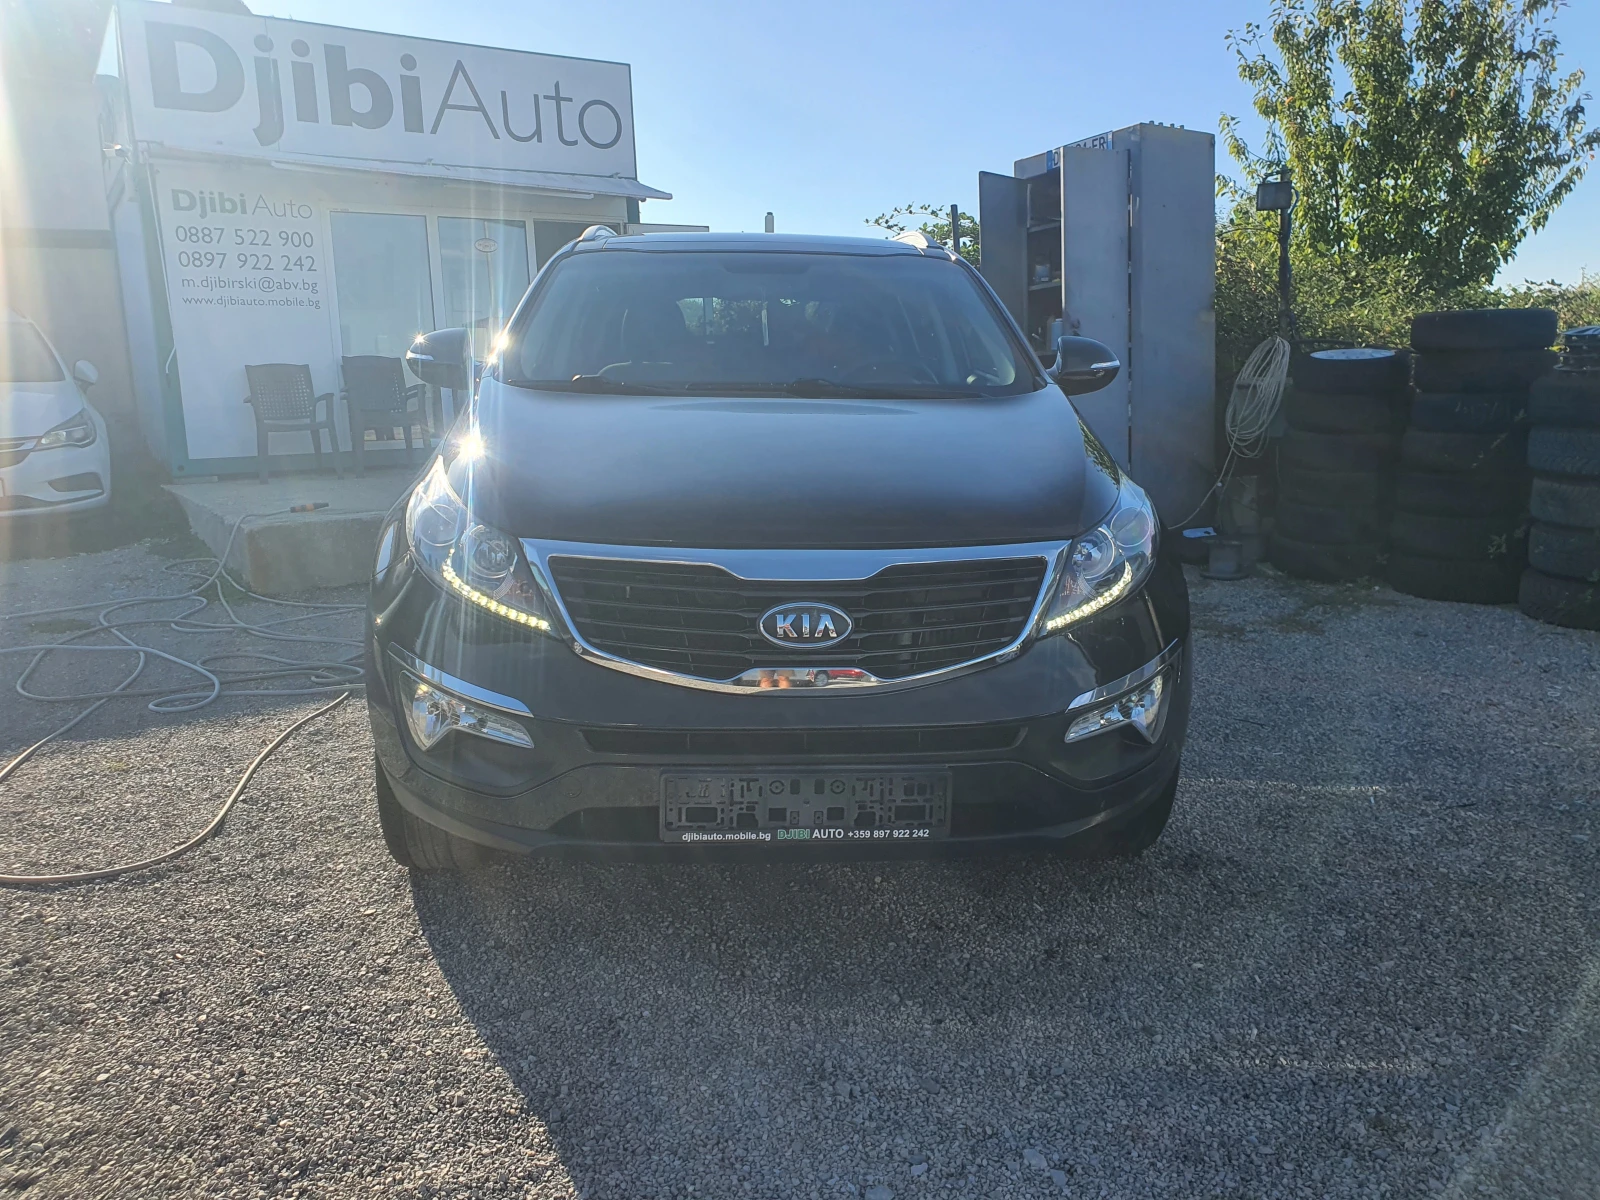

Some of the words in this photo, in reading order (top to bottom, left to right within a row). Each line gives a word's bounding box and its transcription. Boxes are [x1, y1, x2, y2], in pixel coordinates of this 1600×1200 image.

[175, 225, 225, 244] 0887
[234, 228, 272, 246] 522
[278, 230, 314, 248] 900
[178, 251, 227, 269] 0897
[237, 252, 274, 271] 922
[280, 254, 317, 272] 242
[181, 276, 319, 294] m.djibirski@abv.bg
[182, 296, 321, 309] www.djibiauto.mobile.bg
[775, 613, 838, 638] KIA
[682, 832, 771, 842] djibiauto.mobile.bg
[777, 829, 811, 840] DJIBI
[812, 828, 844, 839] AUTO
[847, 830, 871, 839] +359
[873, 829, 890, 838] 897
[892, 829, 910, 838] 922
[912, 829, 930, 837] 242
